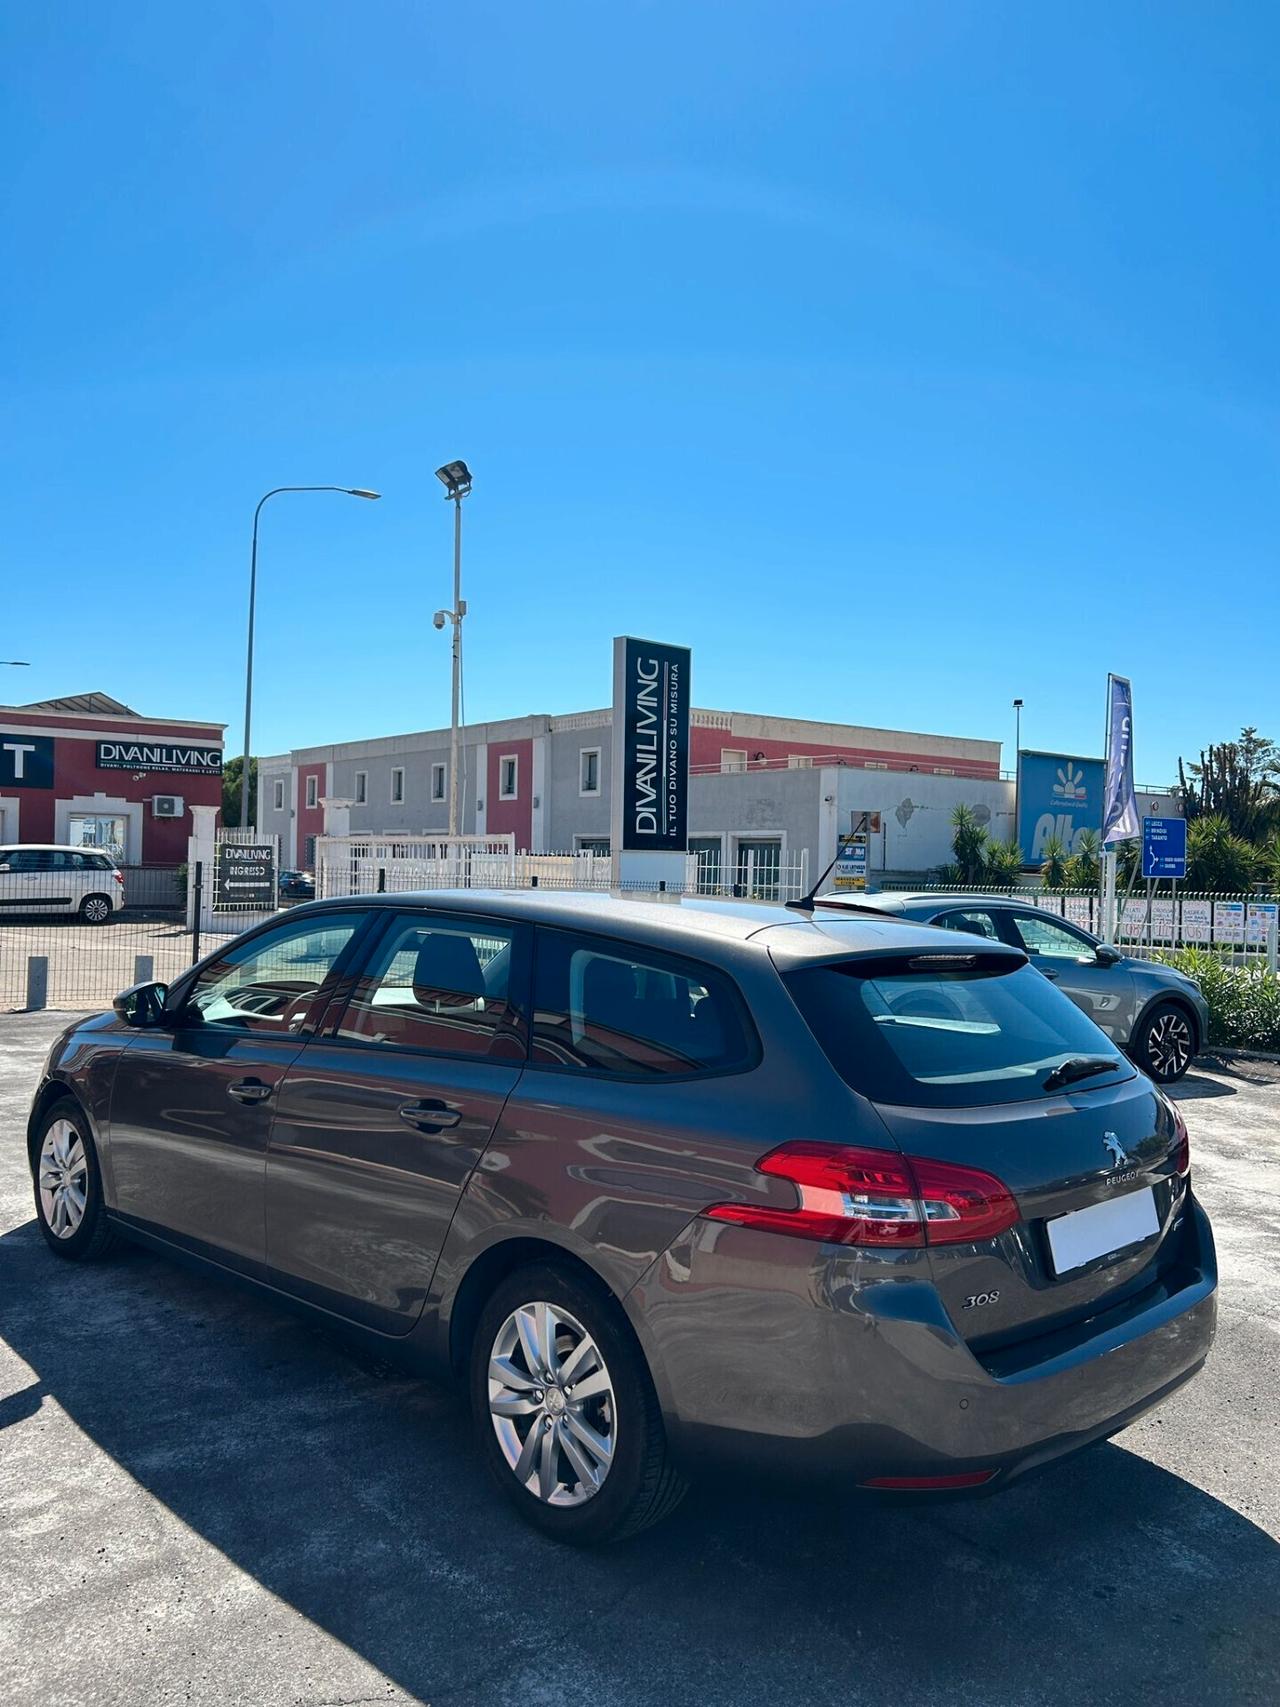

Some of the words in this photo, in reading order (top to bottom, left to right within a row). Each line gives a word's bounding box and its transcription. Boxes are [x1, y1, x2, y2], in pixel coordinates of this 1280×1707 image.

[671, 663, 679, 714] MISURA
[670, 718, 678, 735] SU
[3, 743, 35, 778] T
[669, 739, 678, 791] DIVANO
[669, 794, 677, 821] TUO
[669, 825, 677, 836] IL
[229, 866, 265, 876] INGRESSO
[1106, 1168, 1140, 1186] PEUGEOT
[963, 1290, 1000, 1309] 308
